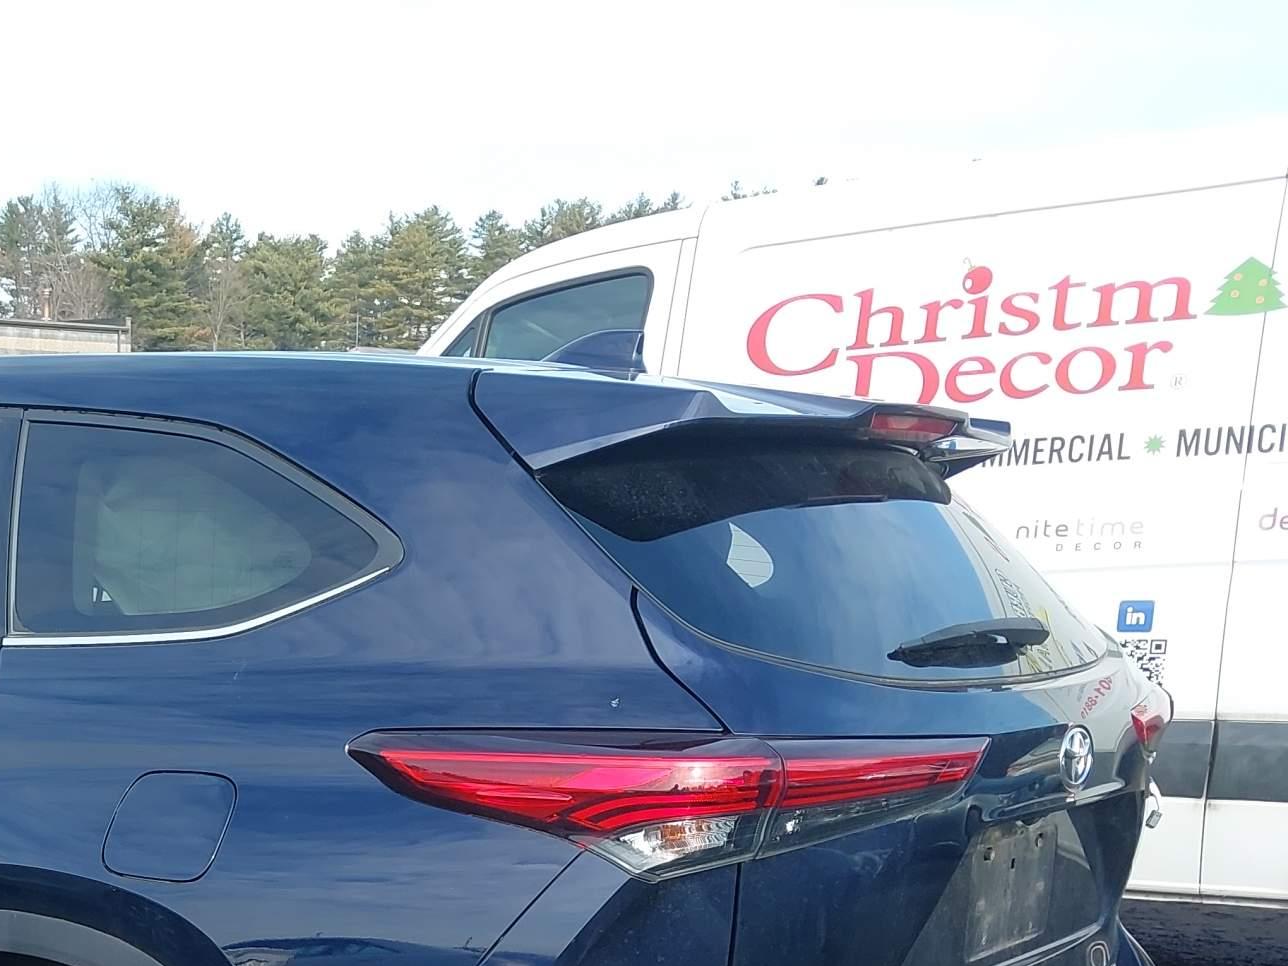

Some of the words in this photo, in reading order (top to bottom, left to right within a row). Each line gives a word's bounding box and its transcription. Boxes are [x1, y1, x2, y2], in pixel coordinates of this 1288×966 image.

[846, 340, 1173, 405] Decor
[1176, 424, 1287, 457] MUNICI
[1055, 540, 1142, 552] DECOR
